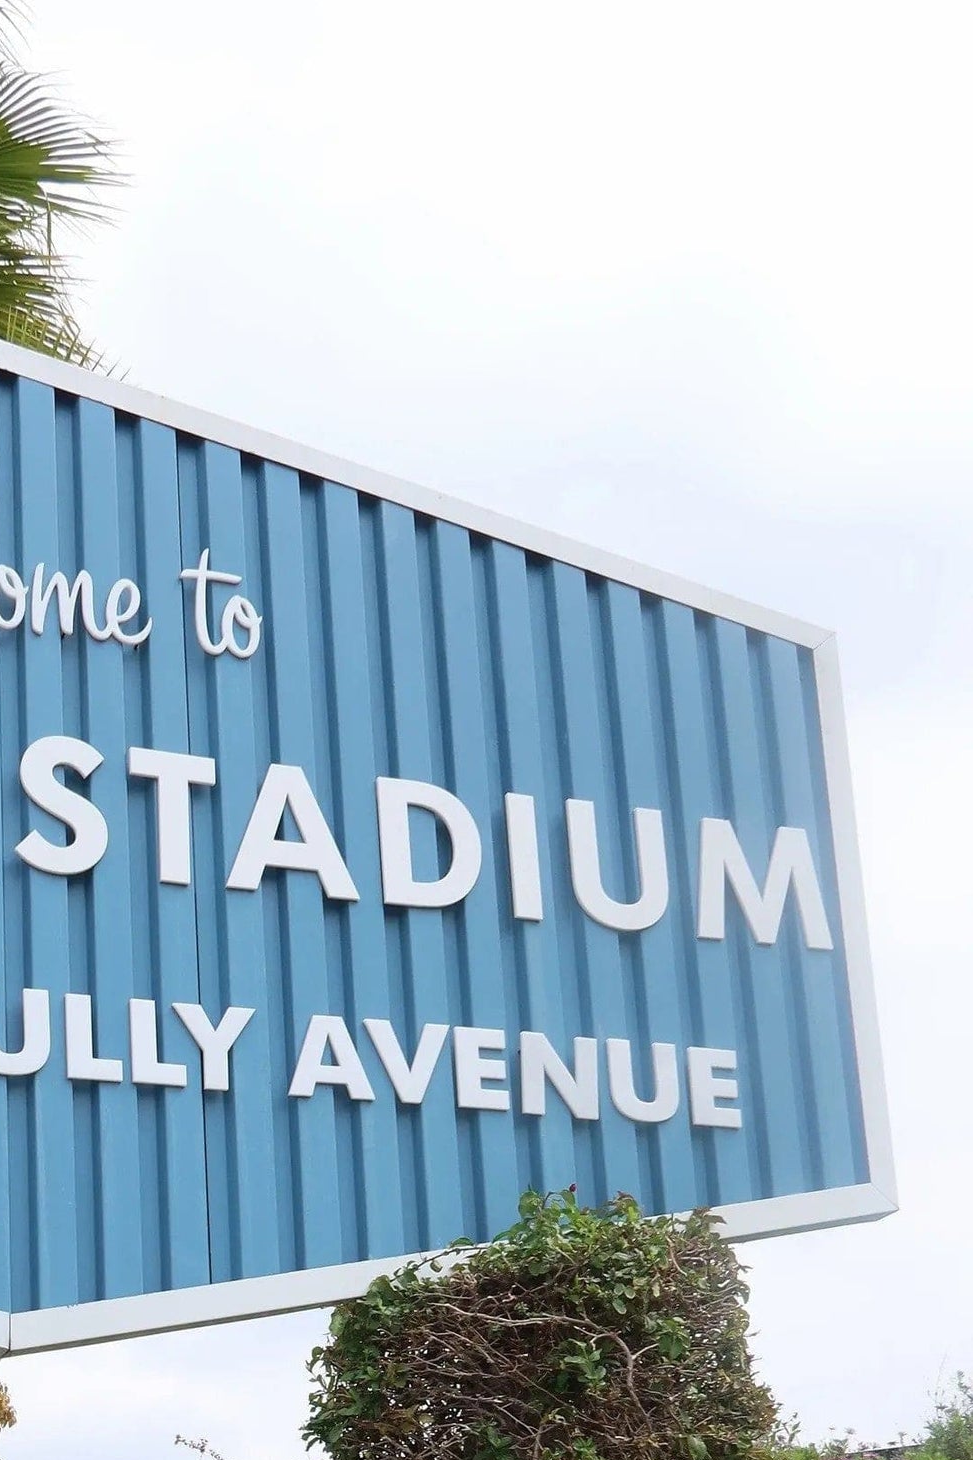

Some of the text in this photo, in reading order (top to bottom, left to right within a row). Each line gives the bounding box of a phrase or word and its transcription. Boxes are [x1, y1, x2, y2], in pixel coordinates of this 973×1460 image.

[179, 547, 264, 659] to
[13, 734, 836, 953] STADIUM
[287, 1013, 743, 1130] AVENUE
